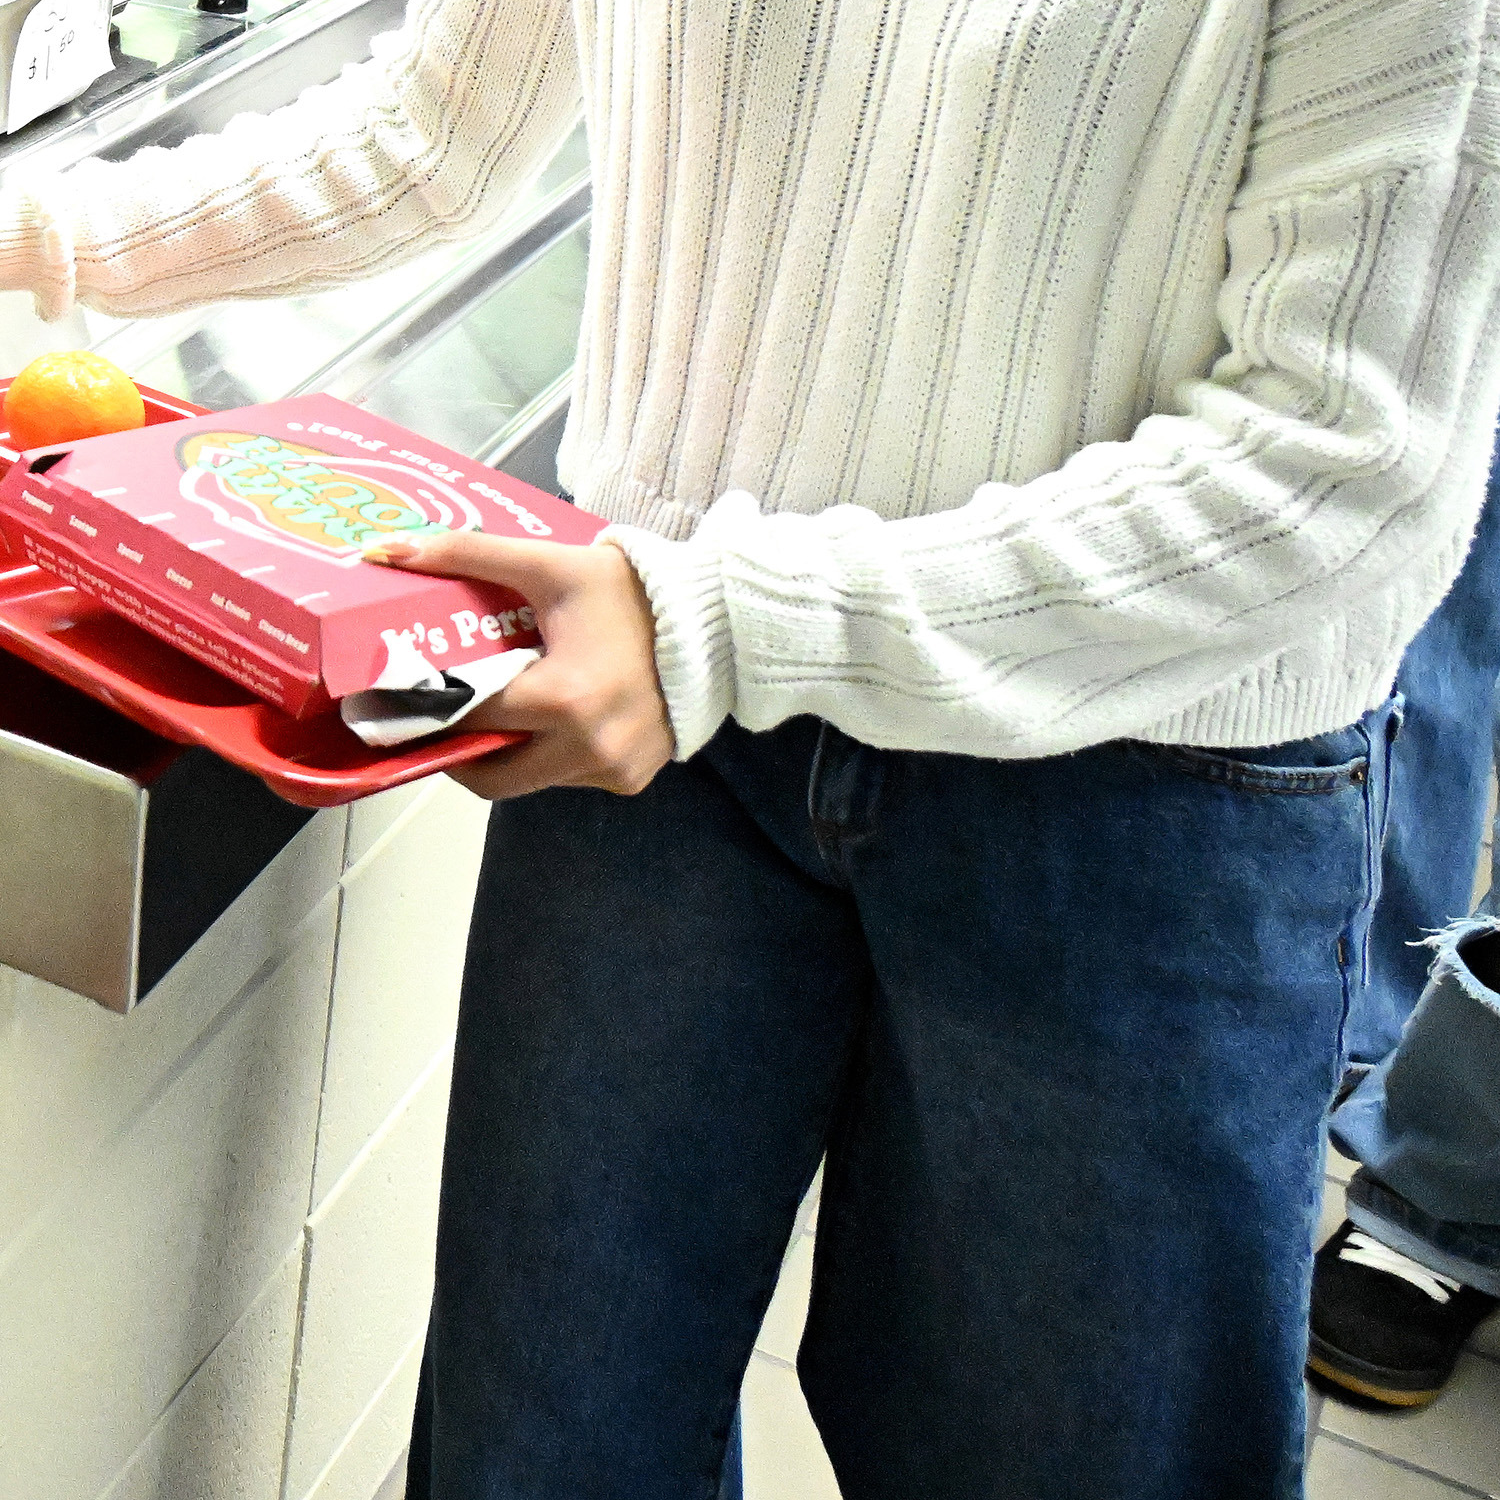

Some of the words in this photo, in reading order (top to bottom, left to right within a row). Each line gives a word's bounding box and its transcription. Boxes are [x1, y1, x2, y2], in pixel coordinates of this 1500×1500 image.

[389, 448, 465, 484] Your
[469, 480, 553, 536] Choose
[76, 563, 112, 594] happy
[113, 586, 143, 610] with
[144, 604, 172, 626] your
